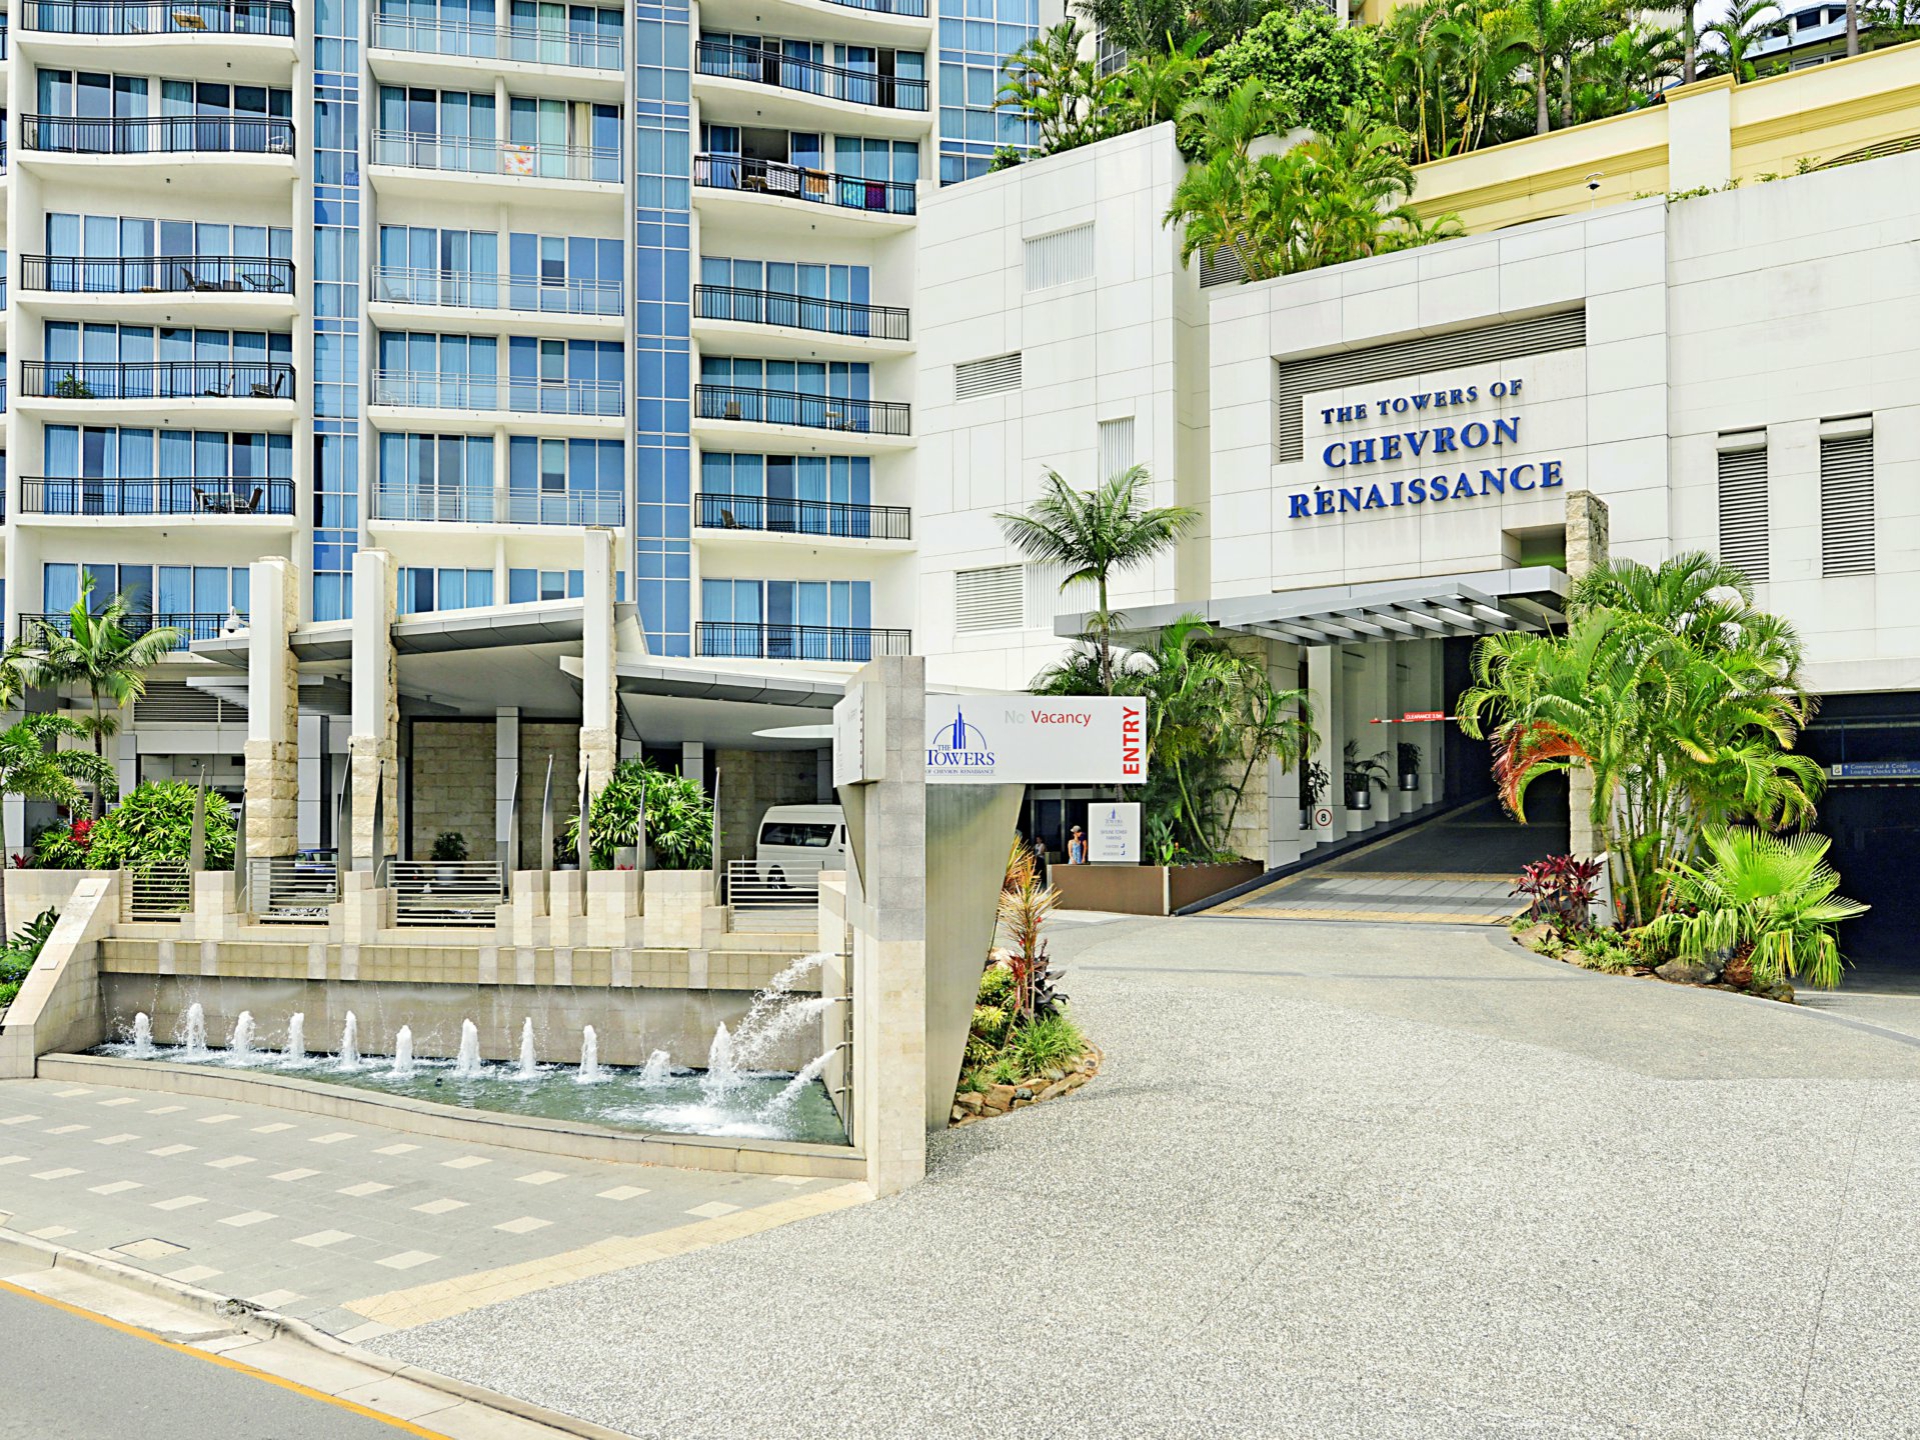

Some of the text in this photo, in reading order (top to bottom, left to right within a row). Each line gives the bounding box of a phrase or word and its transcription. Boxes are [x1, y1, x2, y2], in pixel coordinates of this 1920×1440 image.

[1321, 379, 1523, 424] THE TOWERS OF
[1322, 417, 1520, 469] CHEVRON
[1004, 710, 1091, 727] No Vacancy
[1122, 706, 1139, 774] ENTRY
[925, 749, 995, 766] TOWERS
[1320, 813, 1327, 822] 8
